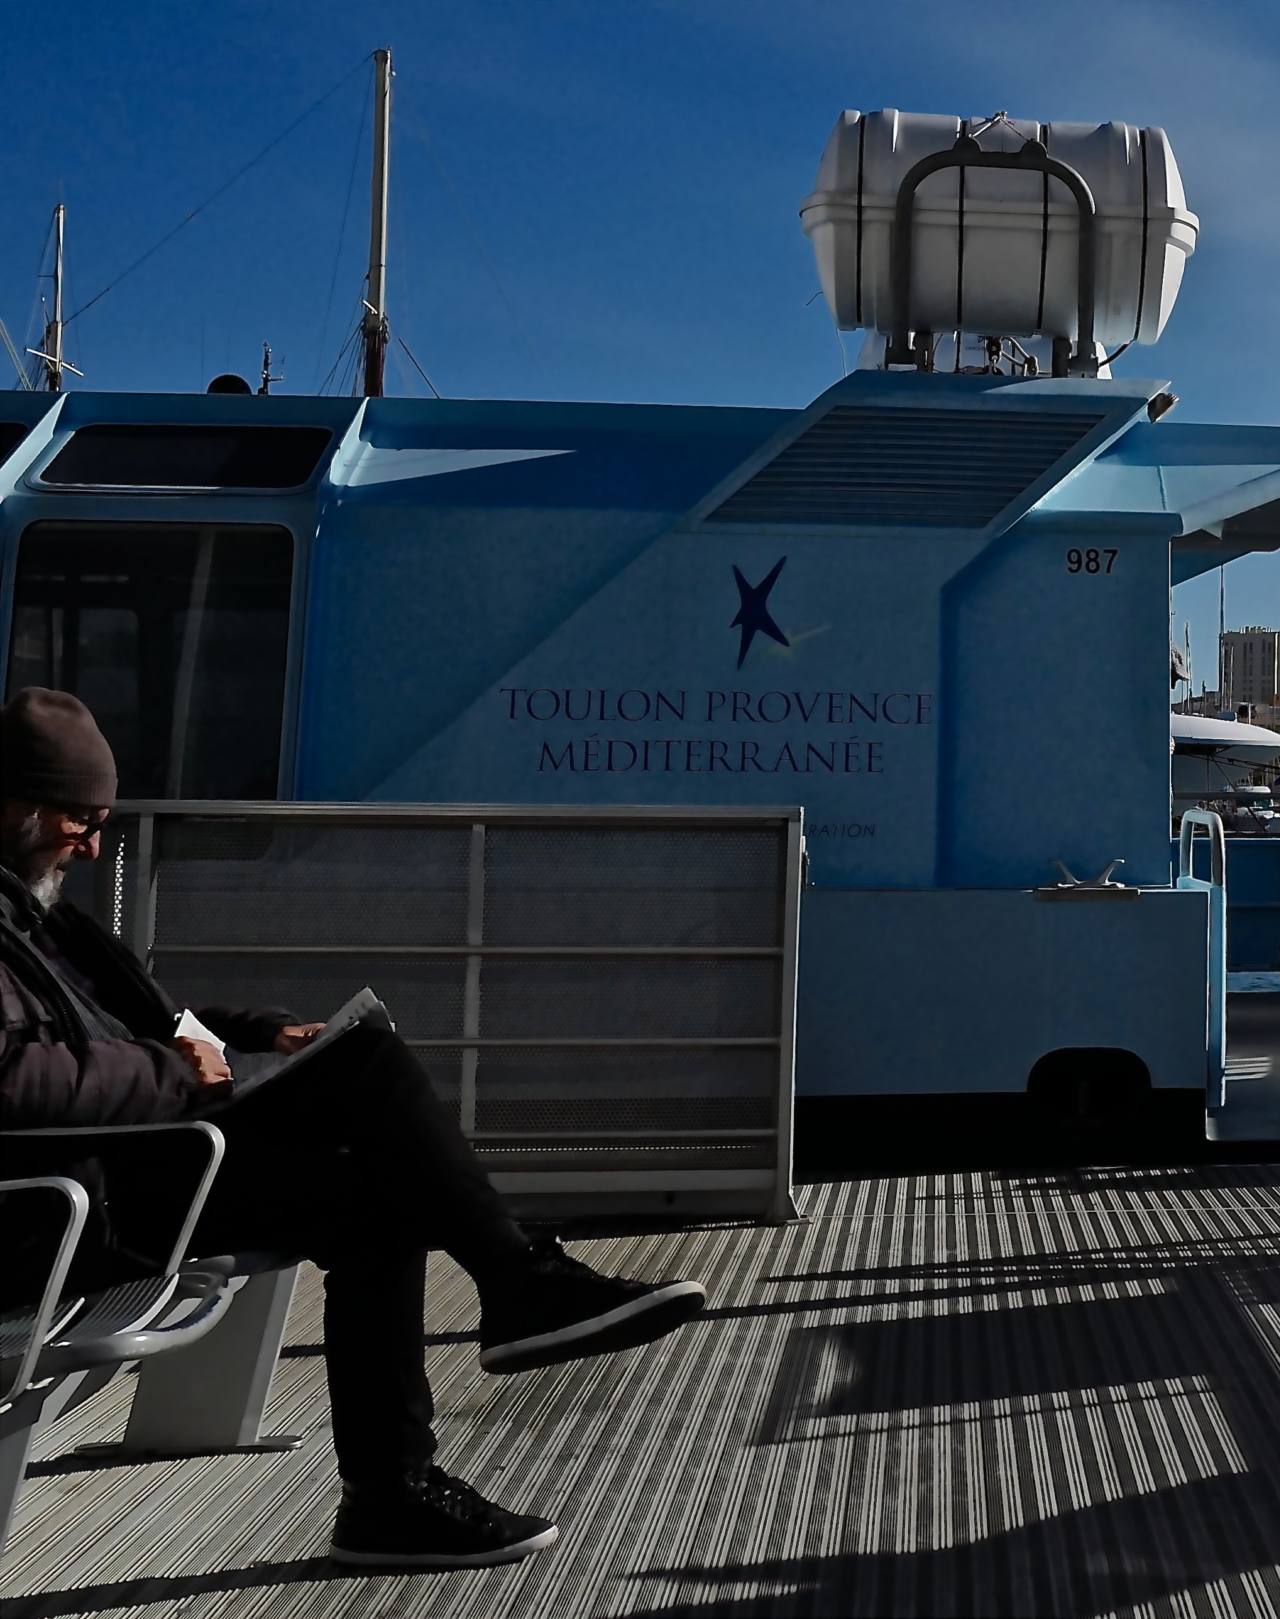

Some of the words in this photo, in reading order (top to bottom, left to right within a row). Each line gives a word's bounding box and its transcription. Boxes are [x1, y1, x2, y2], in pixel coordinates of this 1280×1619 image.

[1067, 548, 1118, 573] 987
[500, 688, 686, 721] TOULON
[705, 690, 932, 724] PROVENCE
[536, 733, 884, 773] MÉDITERRANÉE
[807, 823, 876, 838] RATION
